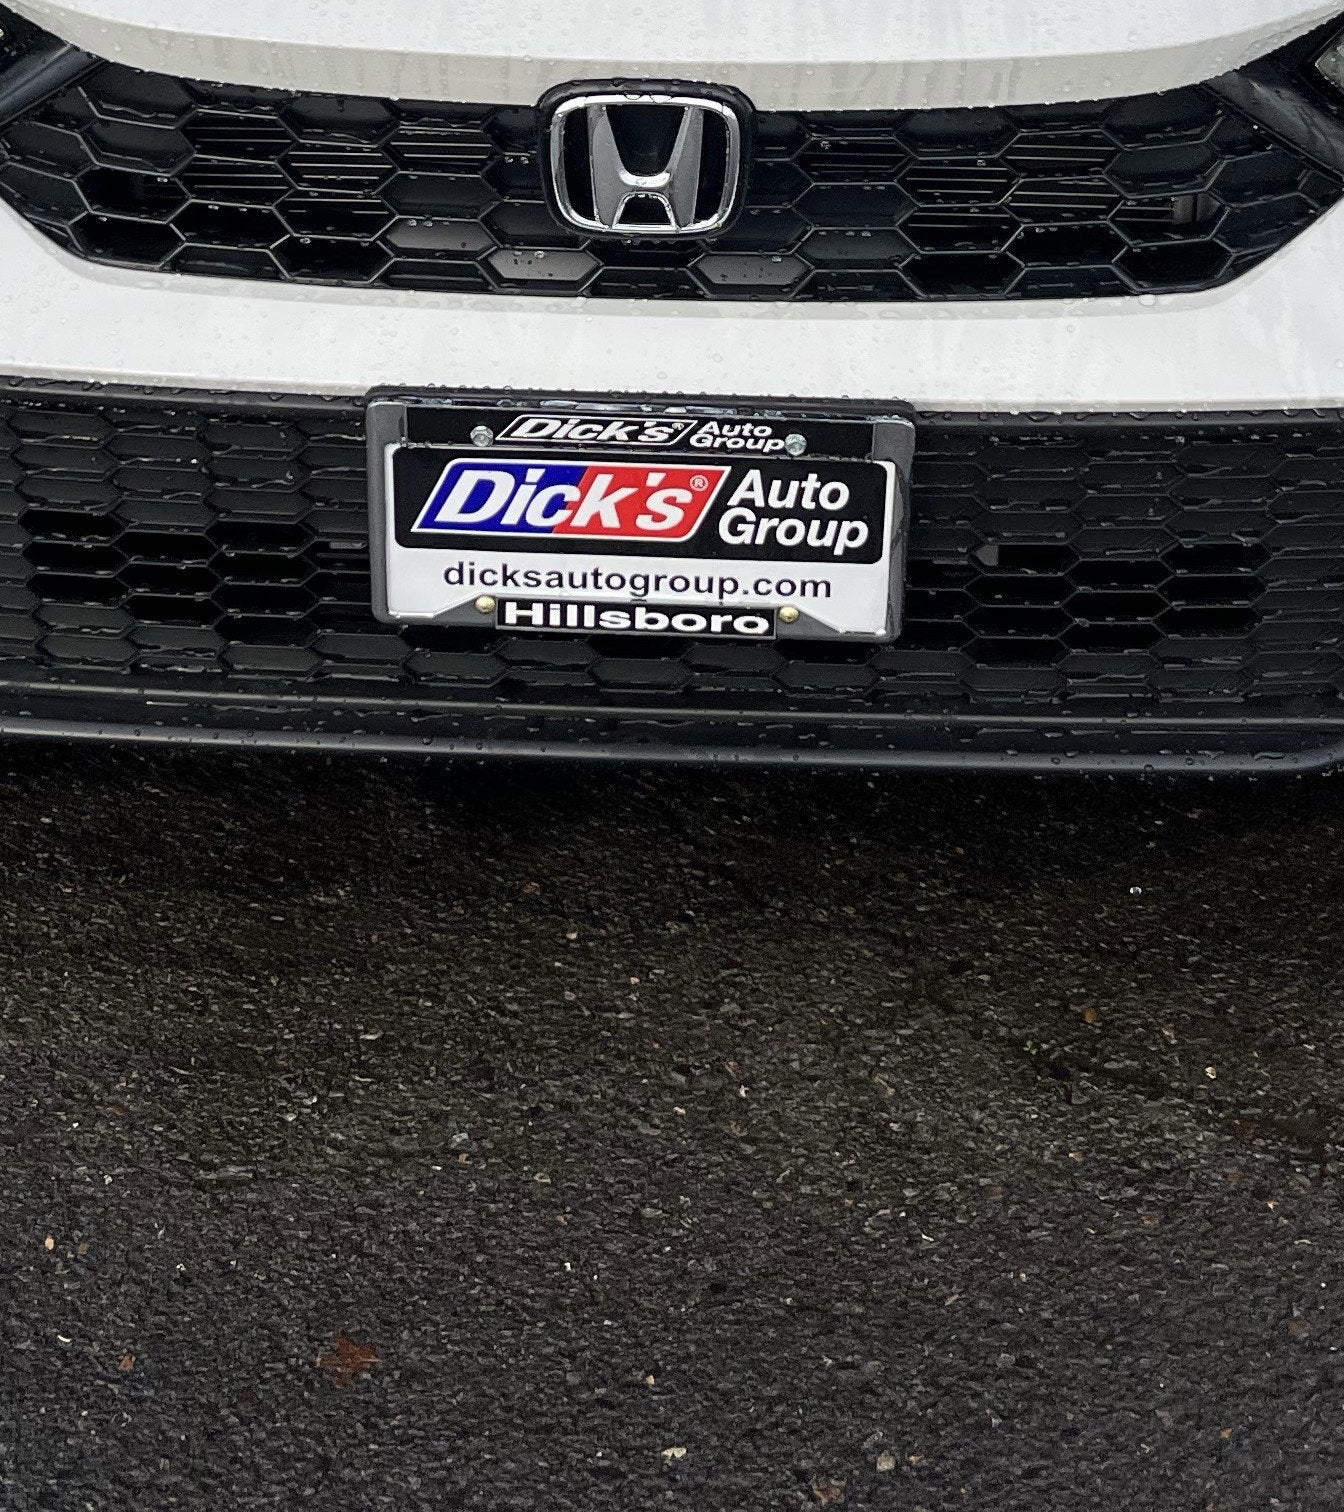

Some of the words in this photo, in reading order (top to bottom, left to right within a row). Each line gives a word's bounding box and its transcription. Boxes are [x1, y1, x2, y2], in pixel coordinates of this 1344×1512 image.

[689, 434, 786, 453] Group
[696, 420, 772, 437] Auto
[727, 469, 850, 510] Auto
[718, 507, 869, 555] Group
[443, 561, 832, 599] dicksautogroup.com
[504, 602, 769, 635] Hillsboro
